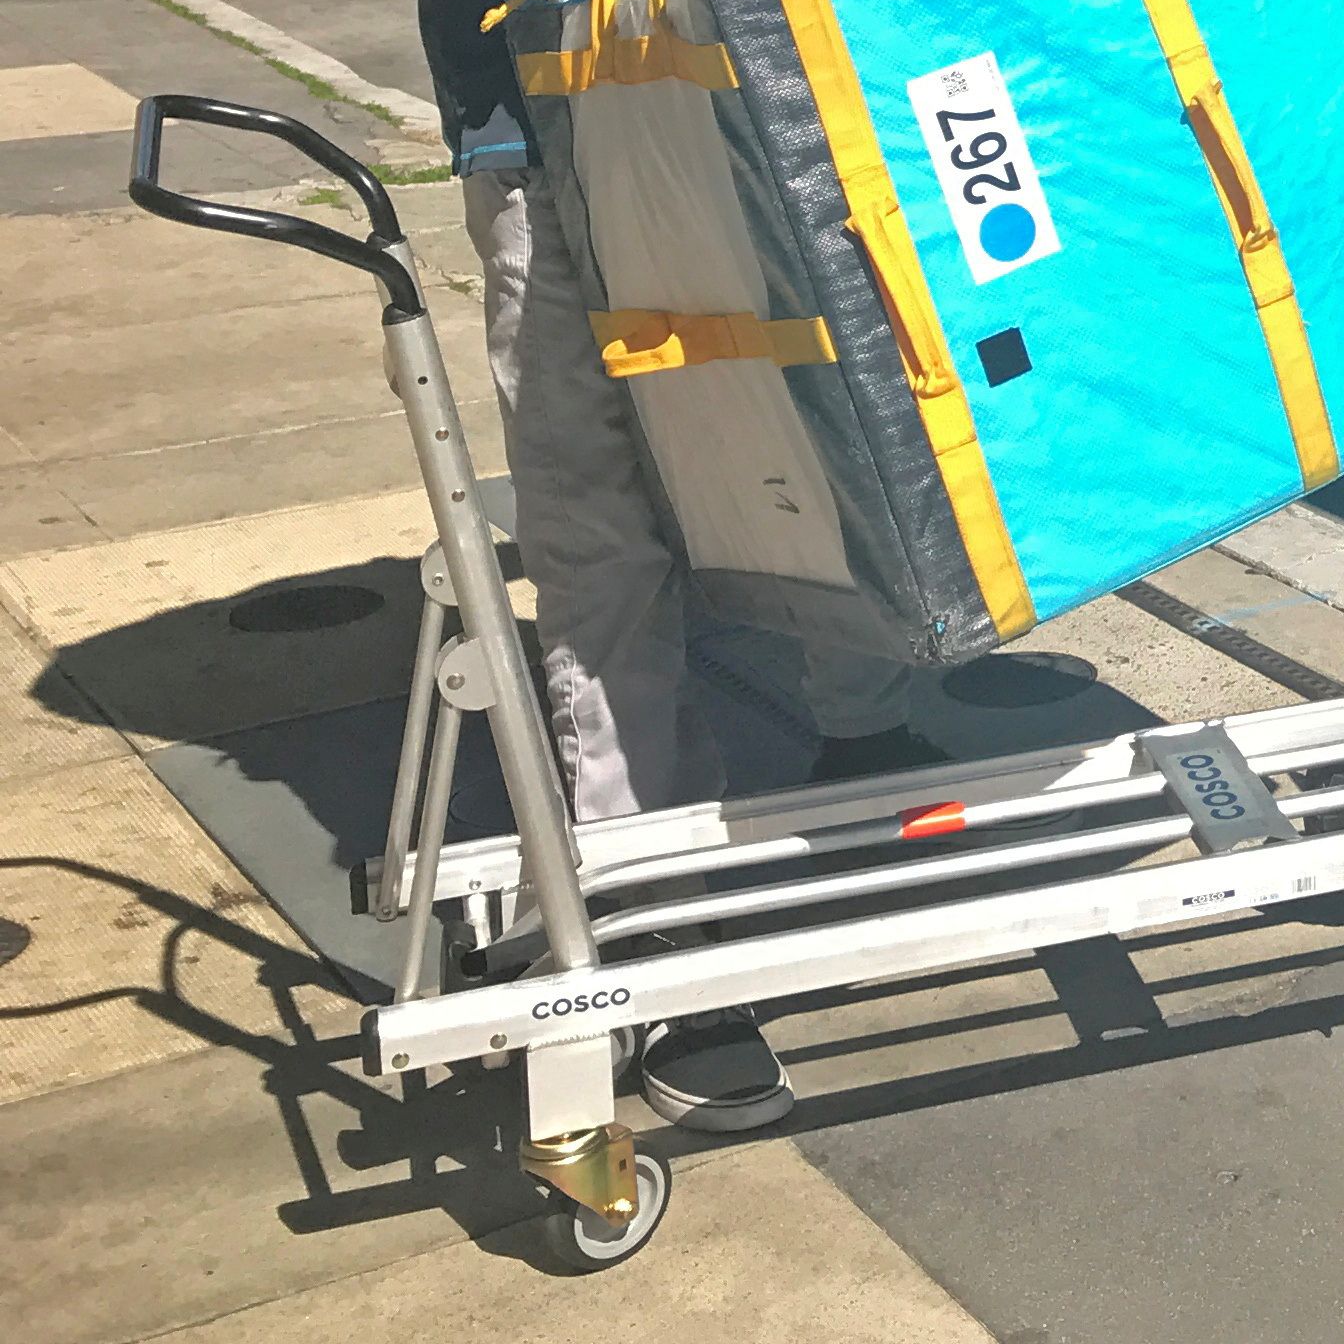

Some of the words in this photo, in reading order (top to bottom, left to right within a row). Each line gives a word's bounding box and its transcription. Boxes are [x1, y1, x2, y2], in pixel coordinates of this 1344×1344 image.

[936, 108, 1021, 205] 267
[1180, 754, 1245, 819] COSCO
[532, 988, 630, 1019] COSCO
